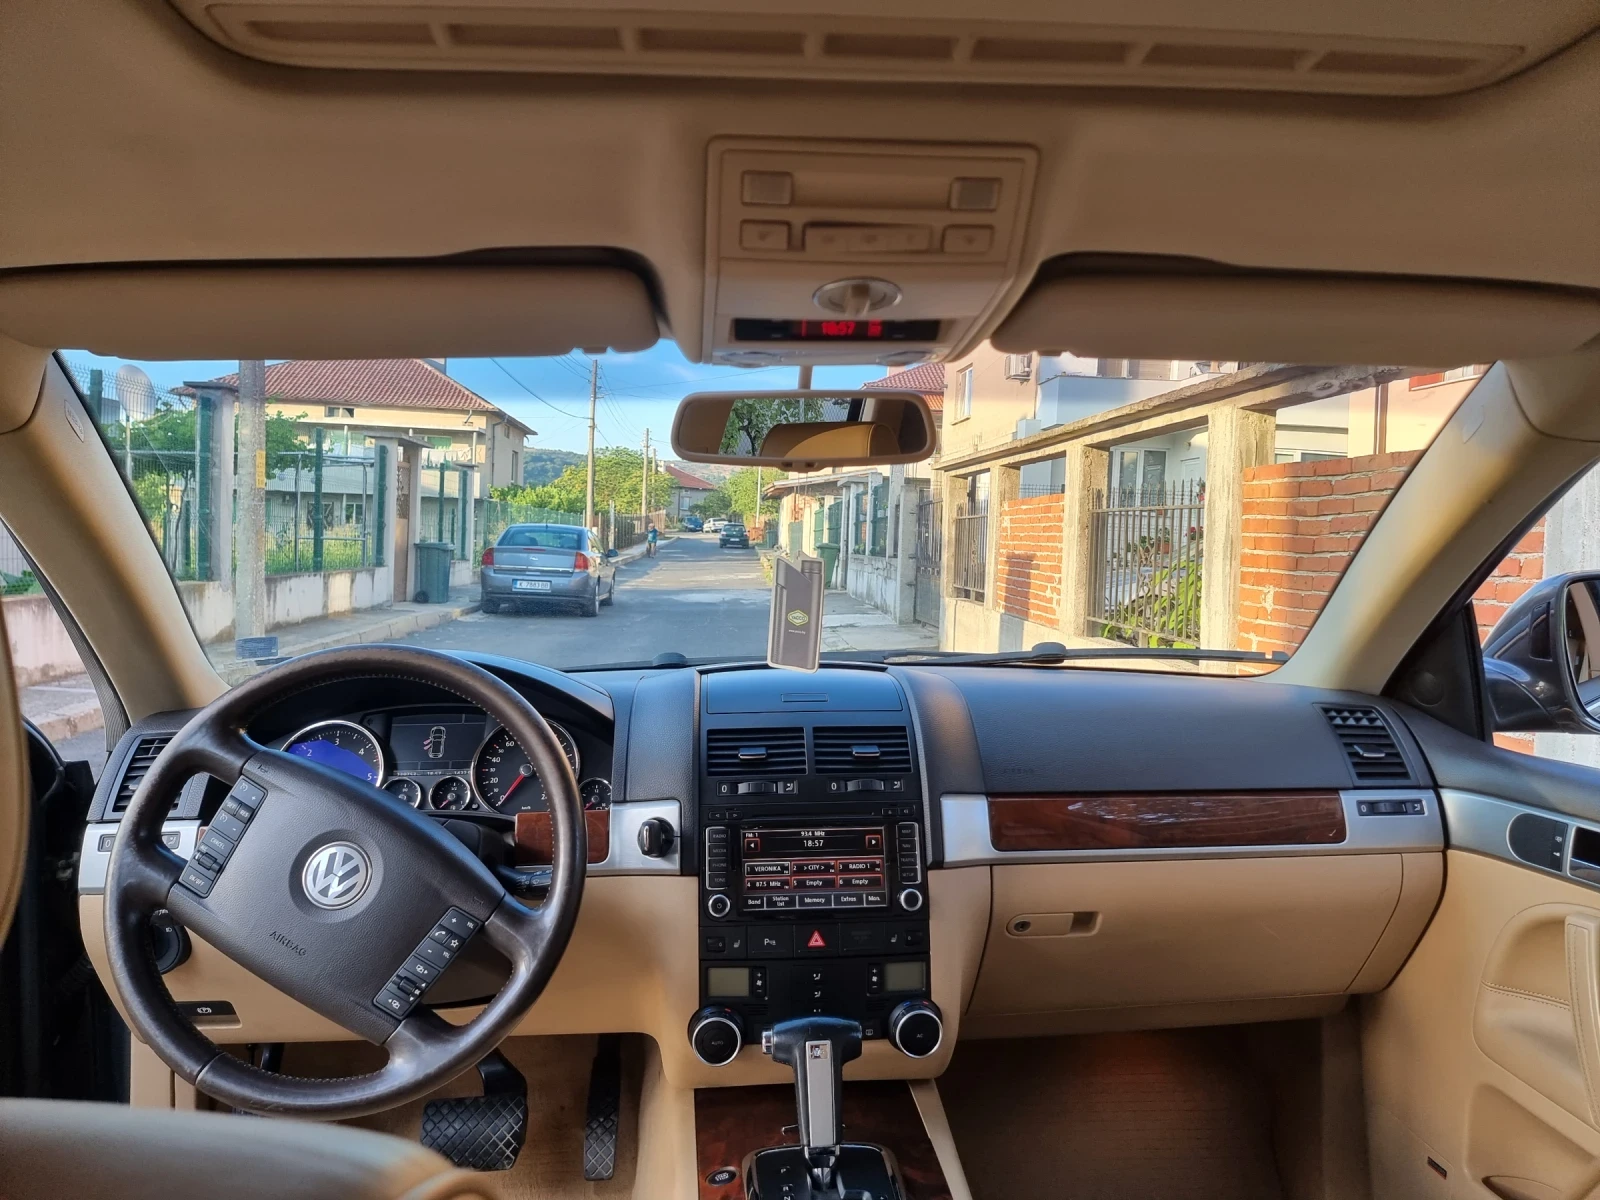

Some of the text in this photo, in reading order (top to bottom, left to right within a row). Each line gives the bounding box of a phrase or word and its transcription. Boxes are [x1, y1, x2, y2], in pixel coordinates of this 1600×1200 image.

[240, 809, 248, 818] RES
[210, 837, 226, 850] CANCEL
[189, 874, 205, 886] ON/OFF
[269, 931, 307, 956] AIRBAG
